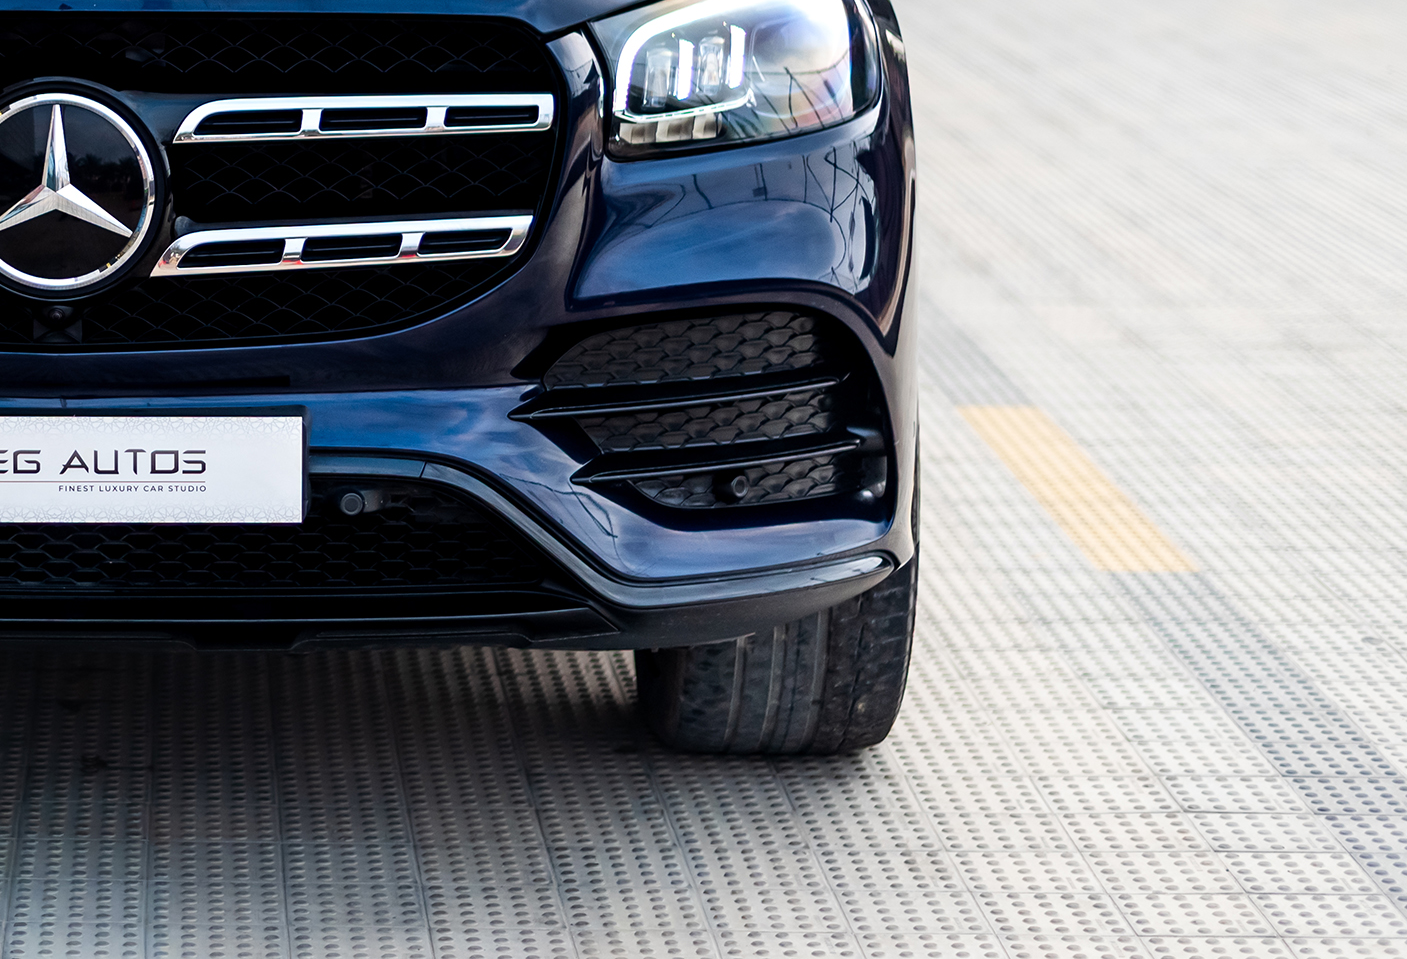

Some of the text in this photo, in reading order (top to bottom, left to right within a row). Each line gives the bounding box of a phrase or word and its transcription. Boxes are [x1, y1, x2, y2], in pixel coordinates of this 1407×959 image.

[59, 449, 207, 475] AUTOS
[58, 484, 207, 493] FINEST LUXURY CAR STUDIO
